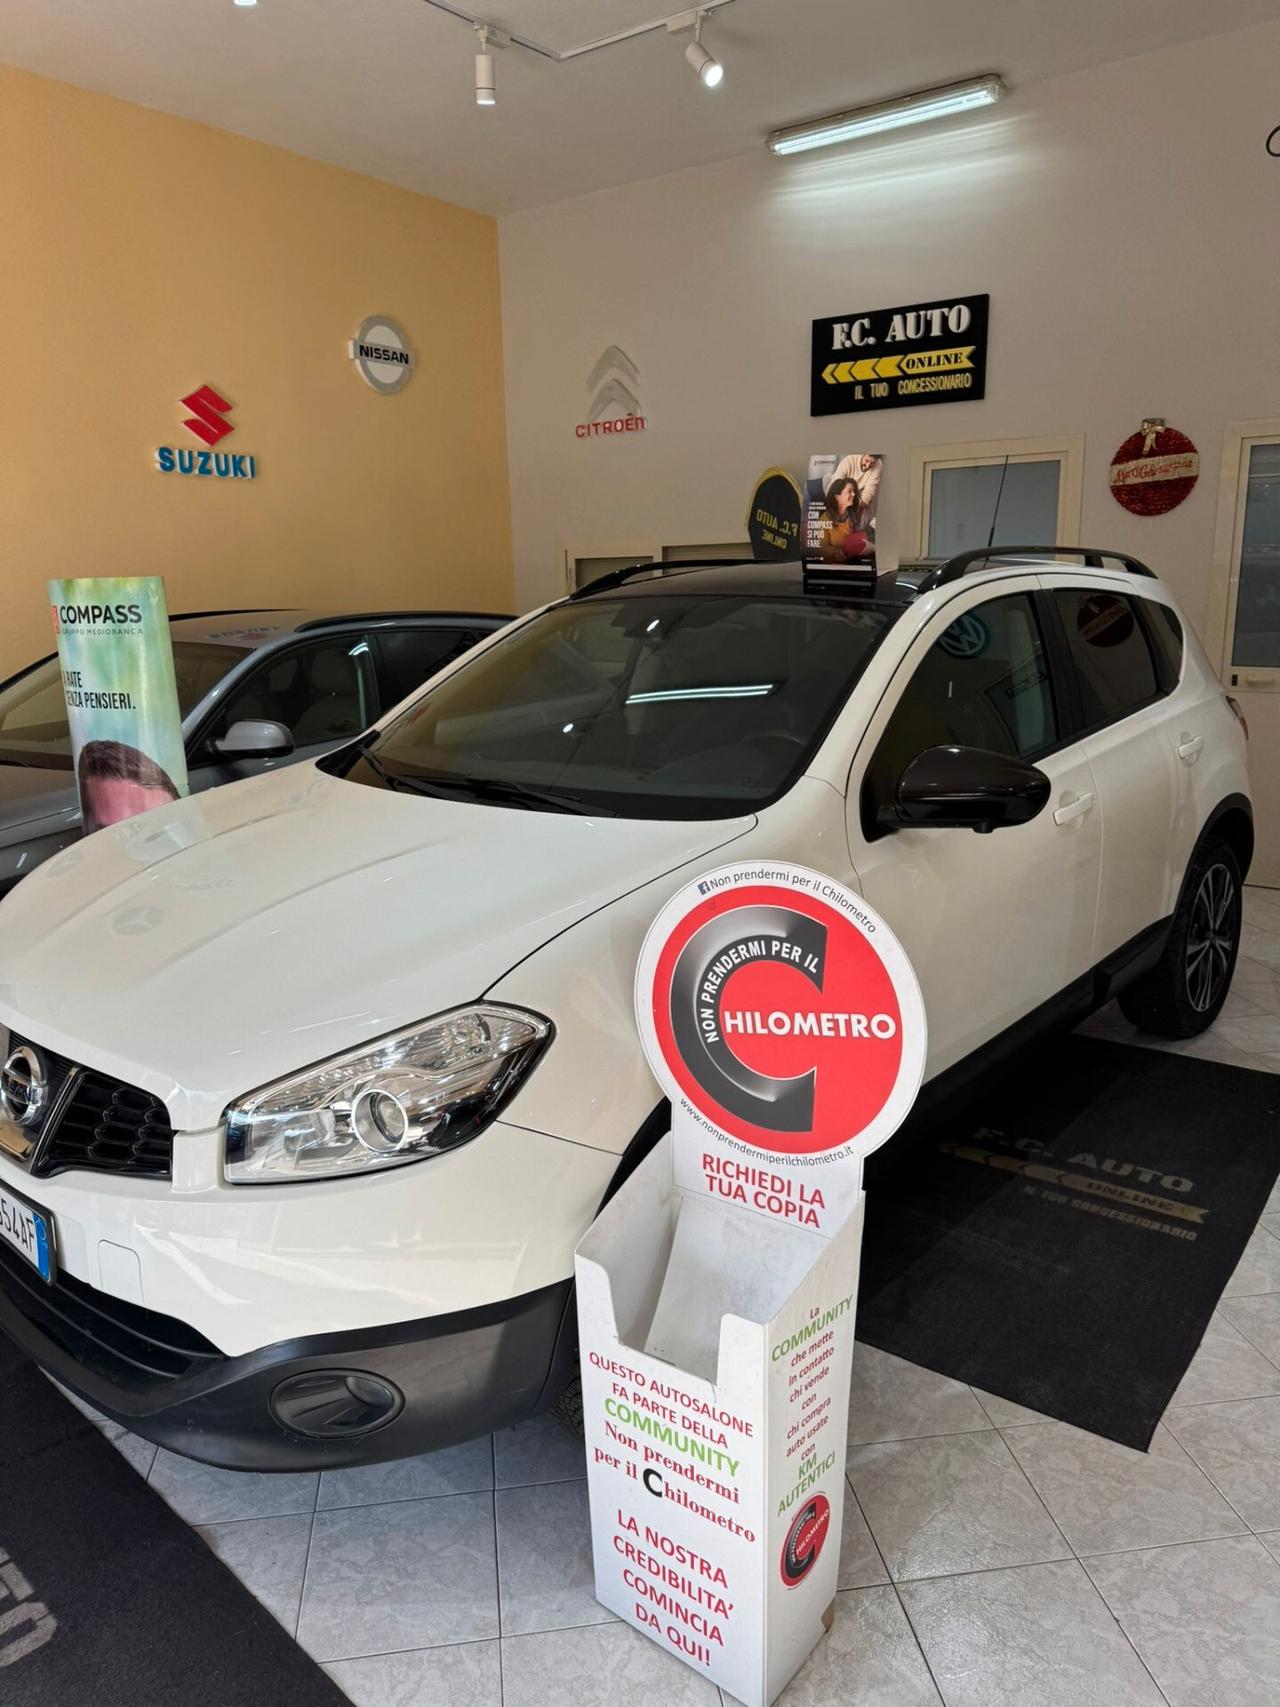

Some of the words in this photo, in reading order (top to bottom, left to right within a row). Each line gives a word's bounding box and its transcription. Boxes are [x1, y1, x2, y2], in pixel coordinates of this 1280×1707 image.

[831, 317, 877, 350] F.C.
[885, 304, 972, 342] AUTO
[358, 344, 410, 365] NISSAN
[905, 351, 964, 370] ONLINE
[854, 385, 864, 400] IL
[870, 383, 889, 398] TUO
[898, 373, 972, 395] CONCESSIONARIO
[156, 446, 256, 480] SUZUKI
[60, 604, 142, 625] COMPASS
[84, 692, 136, 710] PENSIERI.
[709, 876, 732, 891] Non
[733, 869, 791, 883] prendermi
[791, 873, 812, 887] per
[813, 879, 822, 892] il
[821, 884, 877, 934] Chilometro
[700, 939, 767, 1005] PRENDERMI
[771, 939, 803, 964] PER
[803, 953, 819, 975] IL
[701, 1006, 721, 1044] NON
[679, 1096, 855, 1168] www.nonprendermiperilchilometro.it
[702, 1152, 792, 1198] RICHIEDI
[799, 1183, 826, 1210] LA
[1066, 1152, 1194, 1193] AUTO
[705, 1173, 748, 1204] TUA
[753, 1190, 821, 1229] COPIA
[0, 1198, 35, 1253] 54AF
[771, 1294, 853, 1363] COMMUNITY
[809, 1305, 820, 1321] La
[788, 1372, 798, 1387] in
[798, 1346, 834, 1383] contatto
[790, 1348, 807, 1368] che
[807, 1328, 834, 1359] mette
[589, 1350, 646, 1388] QUESTO
[649, 1379, 754, 1438] AUTOSALONE
[789, 1384, 803, 1404] chi
[803, 1364, 830, 1394] vende
[800, 1391, 817, 1412] con
[604, 1397, 741, 1478] COMMUNITY
[611, 1381, 629, 1402] FA
[632, 1390, 677, 1425] PARTE
[681, 1413, 729, 1450] DELLA
[785, 1434, 806, 1459] auto
[805, 1414, 829, 1443] usate
[786, 1421, 801, 1440] chi
[800, 1395, 832, 1432] compra
[604, 1420, 639, 1453] Non
[643, 1443, 741, 1506] prendermi
[798, 1452, 818, 1481] KM
[800, 1441, 817, 1462] con
[594, 1445, 622, 1471] per
[625, 1457, 638, 1480] il
[642, 1466, 757, 1544] Chilometro
[777, 1449, 836, 1518] AUTENTICI
[617, 1508, 641, 1538] LA
[645, 1525, 729, 1590] NOSTRA
[623, 1567, 725, 1648] COMINCIA
[635, 1602, 663, 1635] DA
[666, 1625, 712, 1667] QUI!
